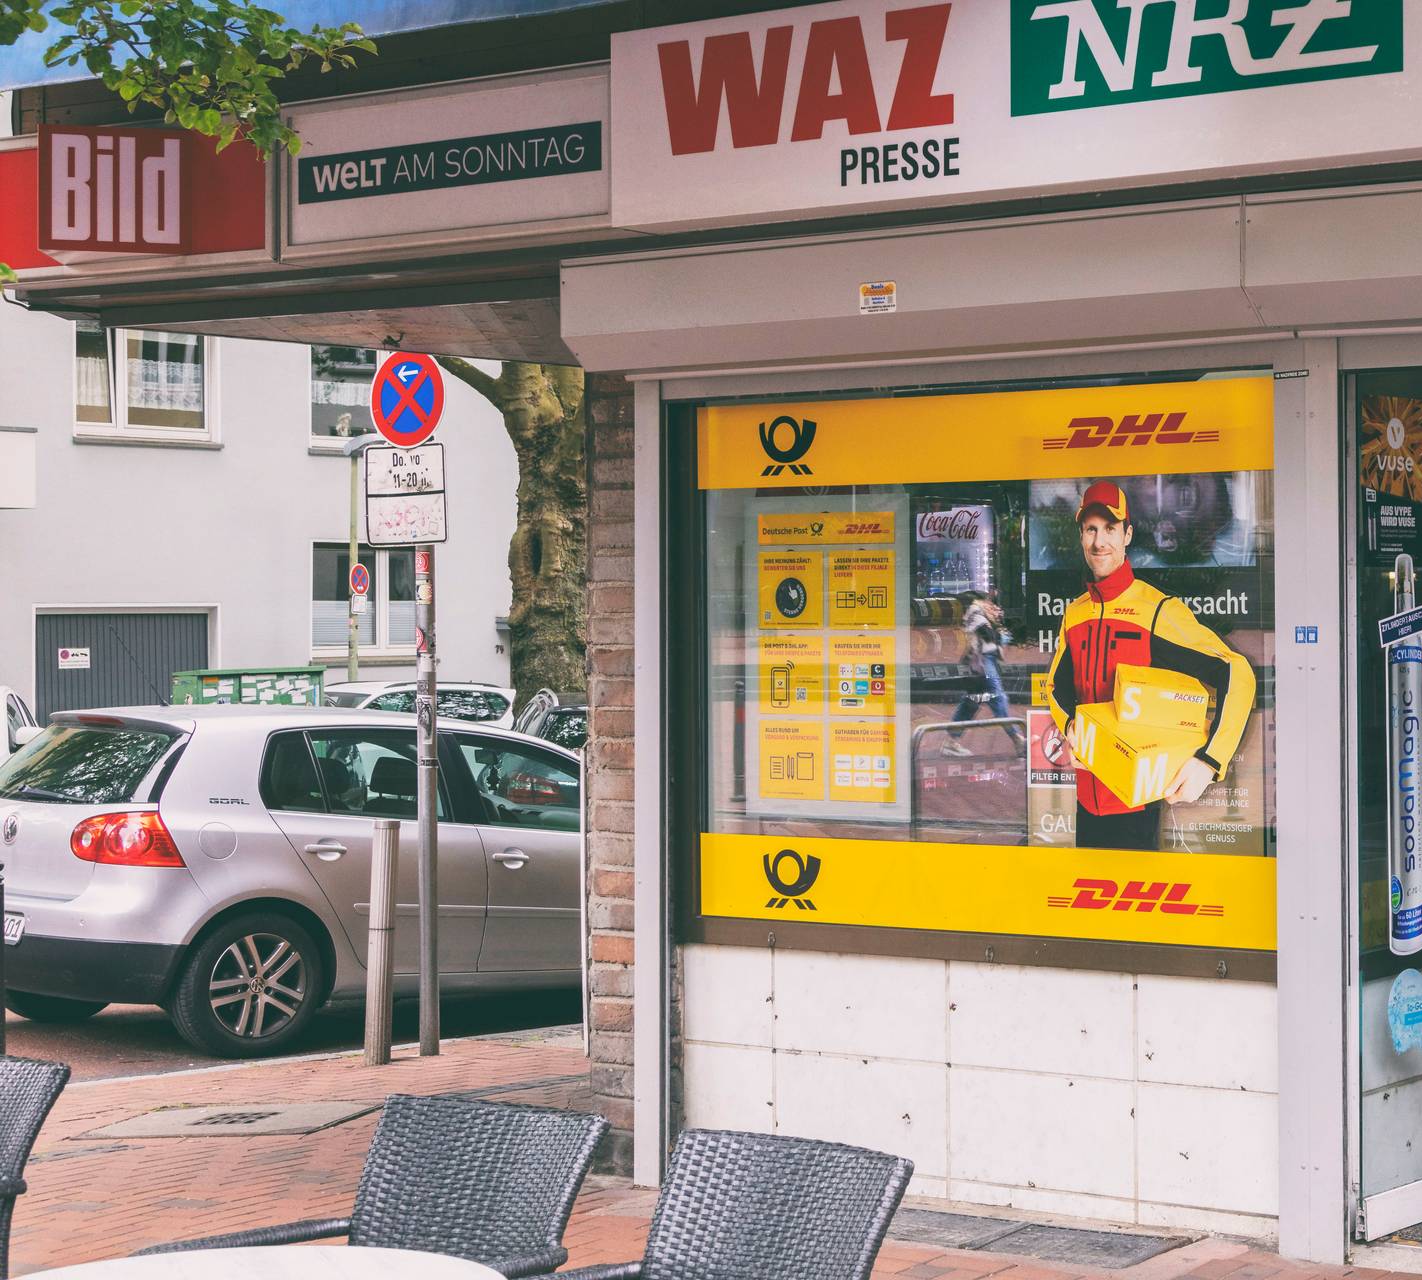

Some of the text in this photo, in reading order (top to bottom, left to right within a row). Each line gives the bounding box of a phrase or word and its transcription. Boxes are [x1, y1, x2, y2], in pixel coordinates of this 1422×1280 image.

[1029, 0, 1381, 101] NRZ
[657, 2, 955, 156] WAZ
[392, 152, 437, 185] AM
[443, 134, 586, 181] SONNTAG
[839, 137, 961, 188] PRESSE
[50, 132, 181, 246] Bild
[1065, 410, 1200, 450] DHL
[392, 452, 407, 468] Do.
[393, 472, 418, 489] 11-20
[1380, 505, 1413, 517] AUS VYPE
[845, 523, 882, 534] DHL
[1380, 516, 1416, 528] WIRD VUSE
[762, 526, 809, 536] Deutsche Post
[1112, 607, 1136, 615] DHL
[1121, 686, 1142, 721] S
[1173, 692, 1206, 704] PACKSET
[1073, 713, 1097, 767] M
[1030, 772, 1059, 782] FILTER
[1131, 753, 1169, 807] M
[1214, 798, 1249, 808] BALANCE
[1205, 832, 1237, 843] GENUSS
[1070, 878, 1202, 917] DHL
